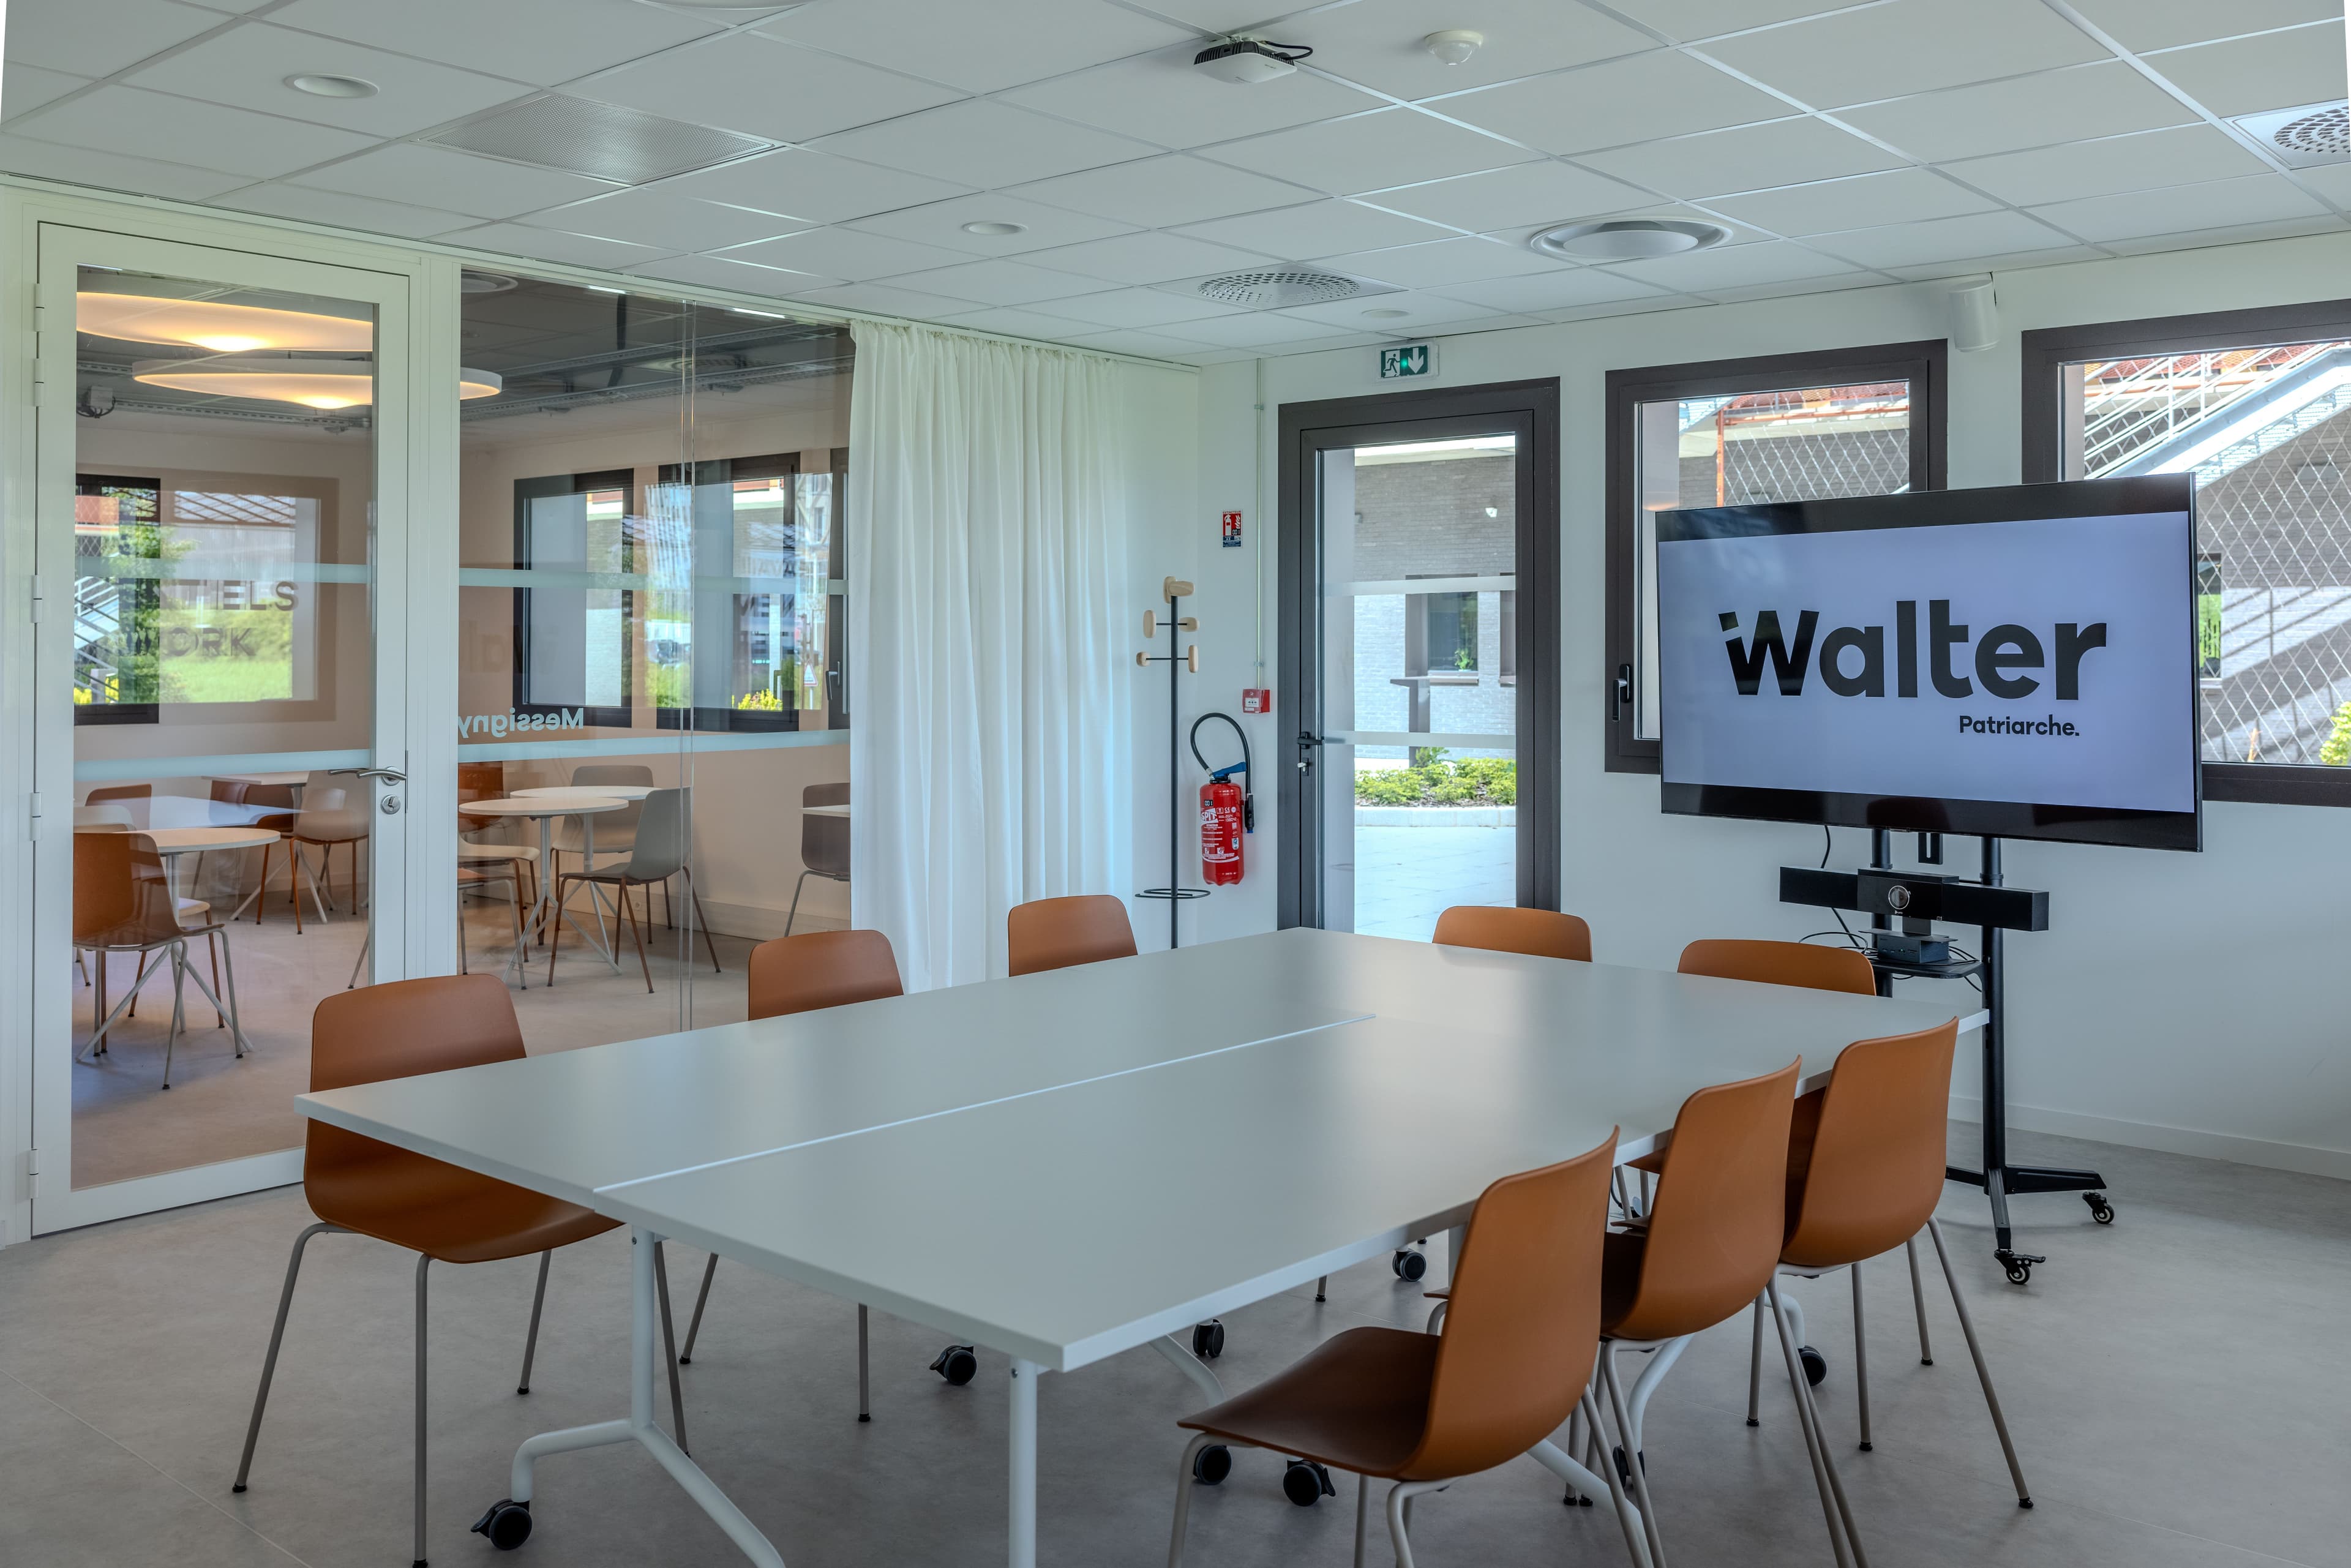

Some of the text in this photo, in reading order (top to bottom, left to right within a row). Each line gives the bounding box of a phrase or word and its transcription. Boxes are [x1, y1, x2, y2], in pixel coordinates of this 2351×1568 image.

[1719, 599, 2107, 700] Walter
[1959, 714, 2080, 736] Patriarche.
[1200, 811, 1217, 821] SPIT
